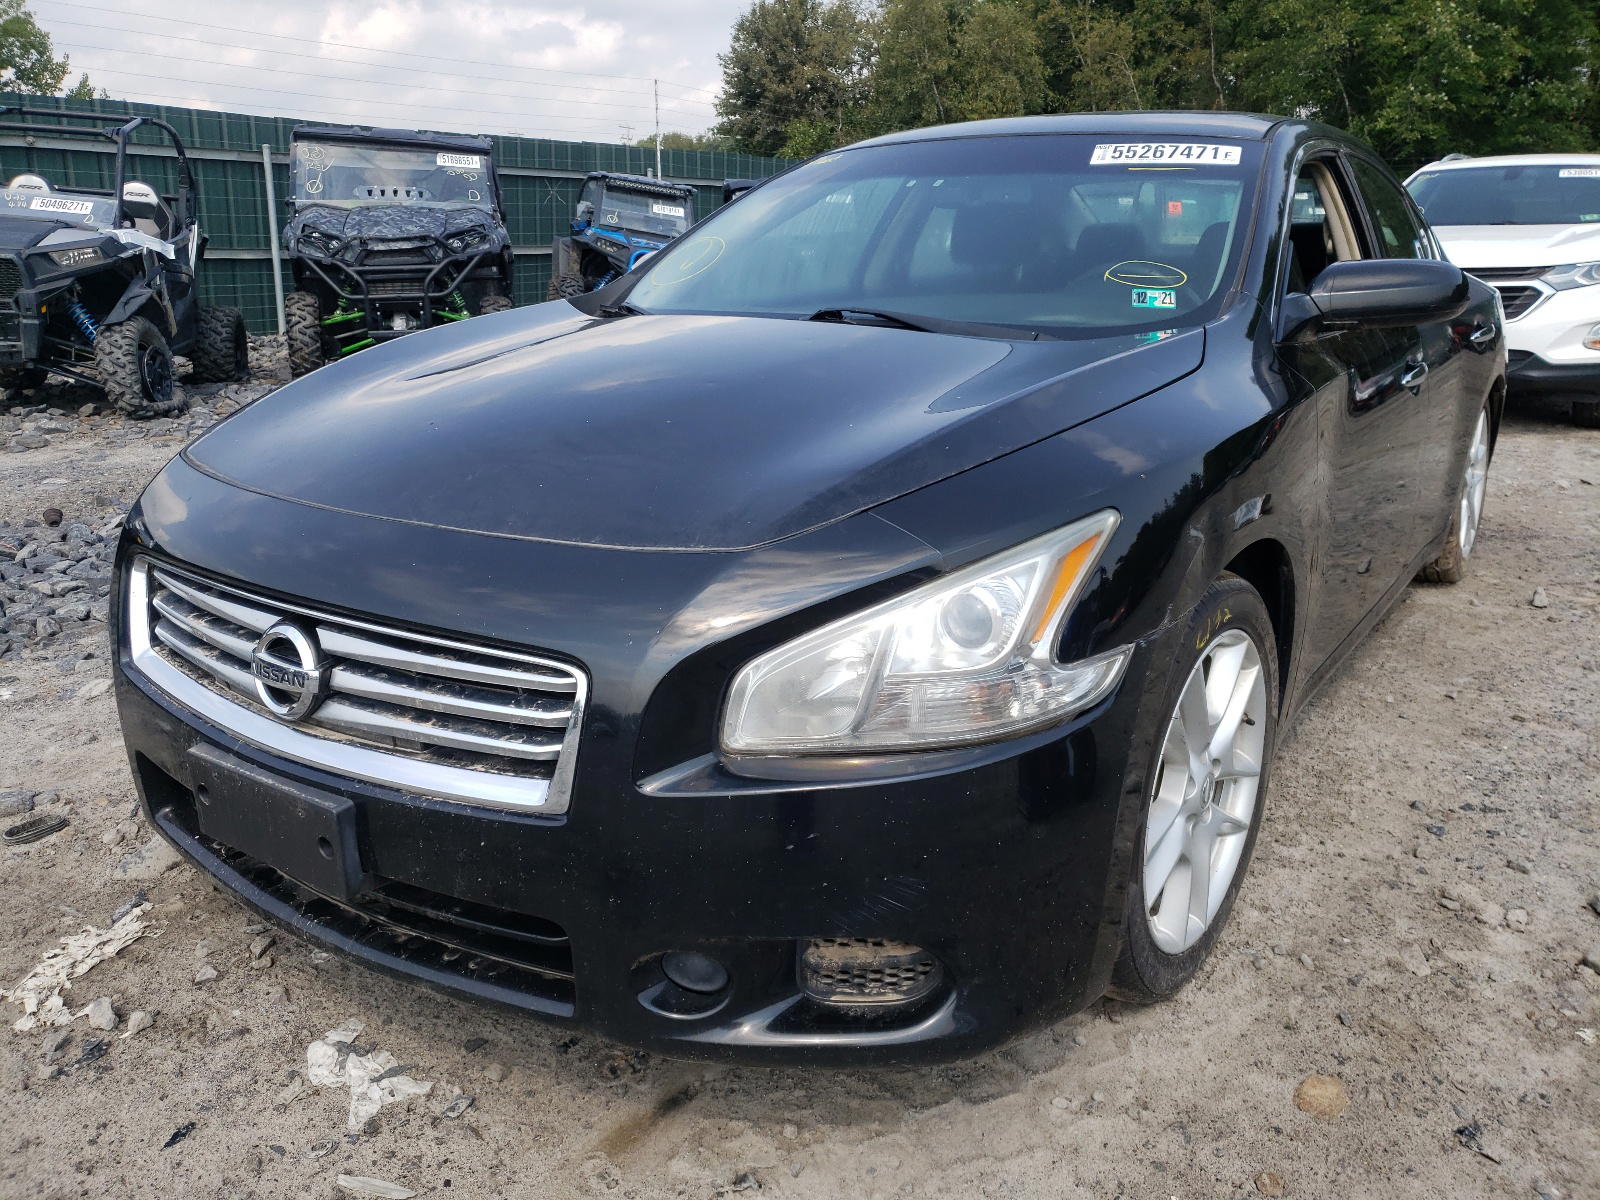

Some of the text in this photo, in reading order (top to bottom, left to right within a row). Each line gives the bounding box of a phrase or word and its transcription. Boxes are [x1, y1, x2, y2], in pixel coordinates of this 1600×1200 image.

[1110, 144, 1220, 160] 55267471
[39, 198, 85, 212] 50496271
[1134, 291, 1175, 305] 12 21
[252, 661, 305, 688] NISSAN
